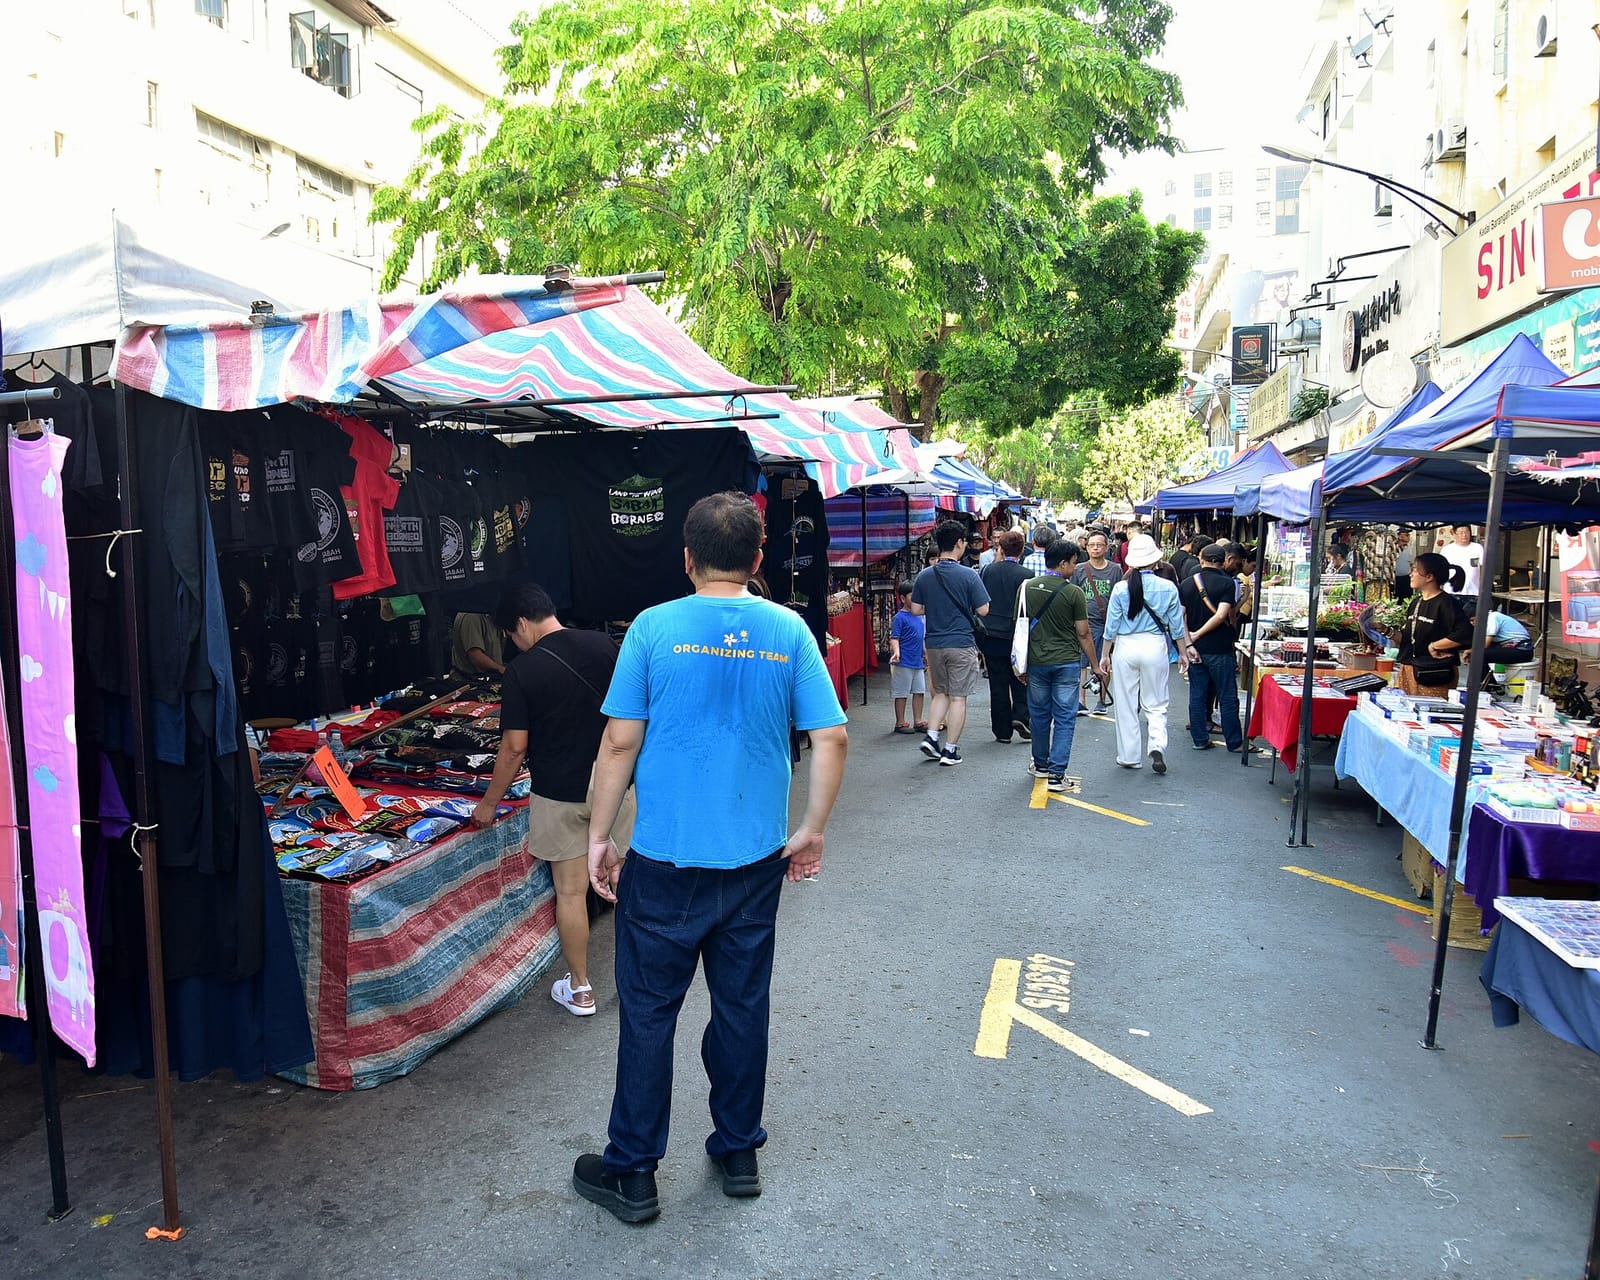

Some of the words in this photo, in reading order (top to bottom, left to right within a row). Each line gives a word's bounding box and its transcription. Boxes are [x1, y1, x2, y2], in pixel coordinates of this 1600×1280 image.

[1551, 164, 1572, 186] Rumah
[1572, 157, 1583, 172] dan
[609, 488, 629, 497] LAND
[611, 511, 664, 525] BORNEO
[386, 532, 420, 541] BORNEO
[672, 643, 755, 659] ORGANIZING
[758, 650, 790, 664] TEAM
